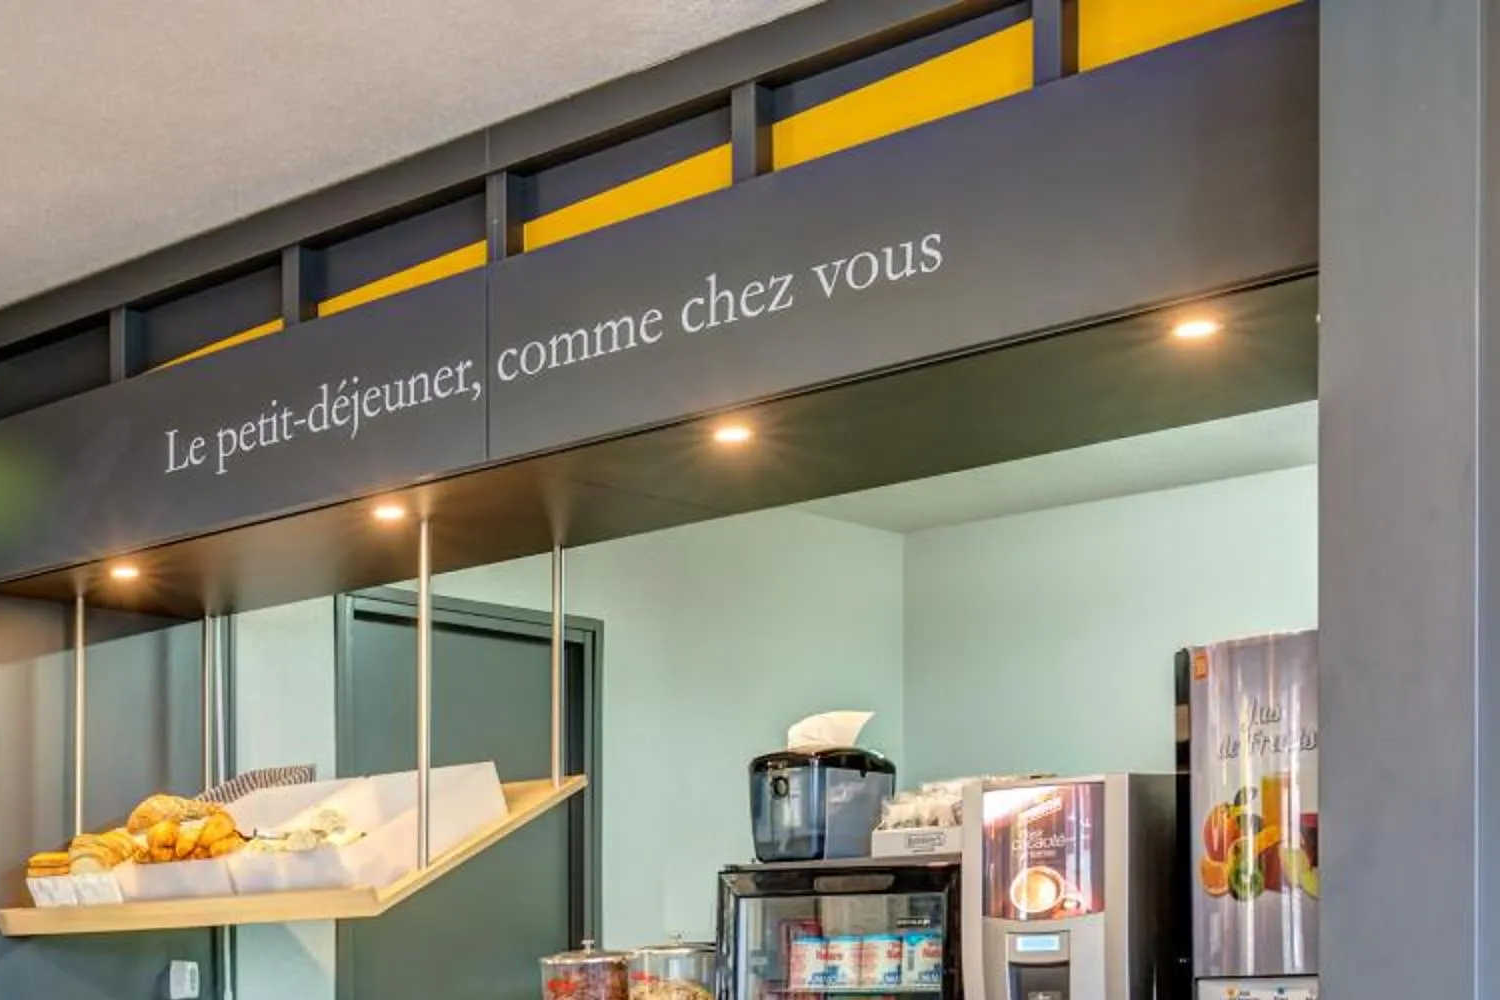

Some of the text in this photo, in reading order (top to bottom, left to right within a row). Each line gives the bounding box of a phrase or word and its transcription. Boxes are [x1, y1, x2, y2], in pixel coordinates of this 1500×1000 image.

[164, 233, 943, 475] Le petit-déjeuner, comme chez vous
